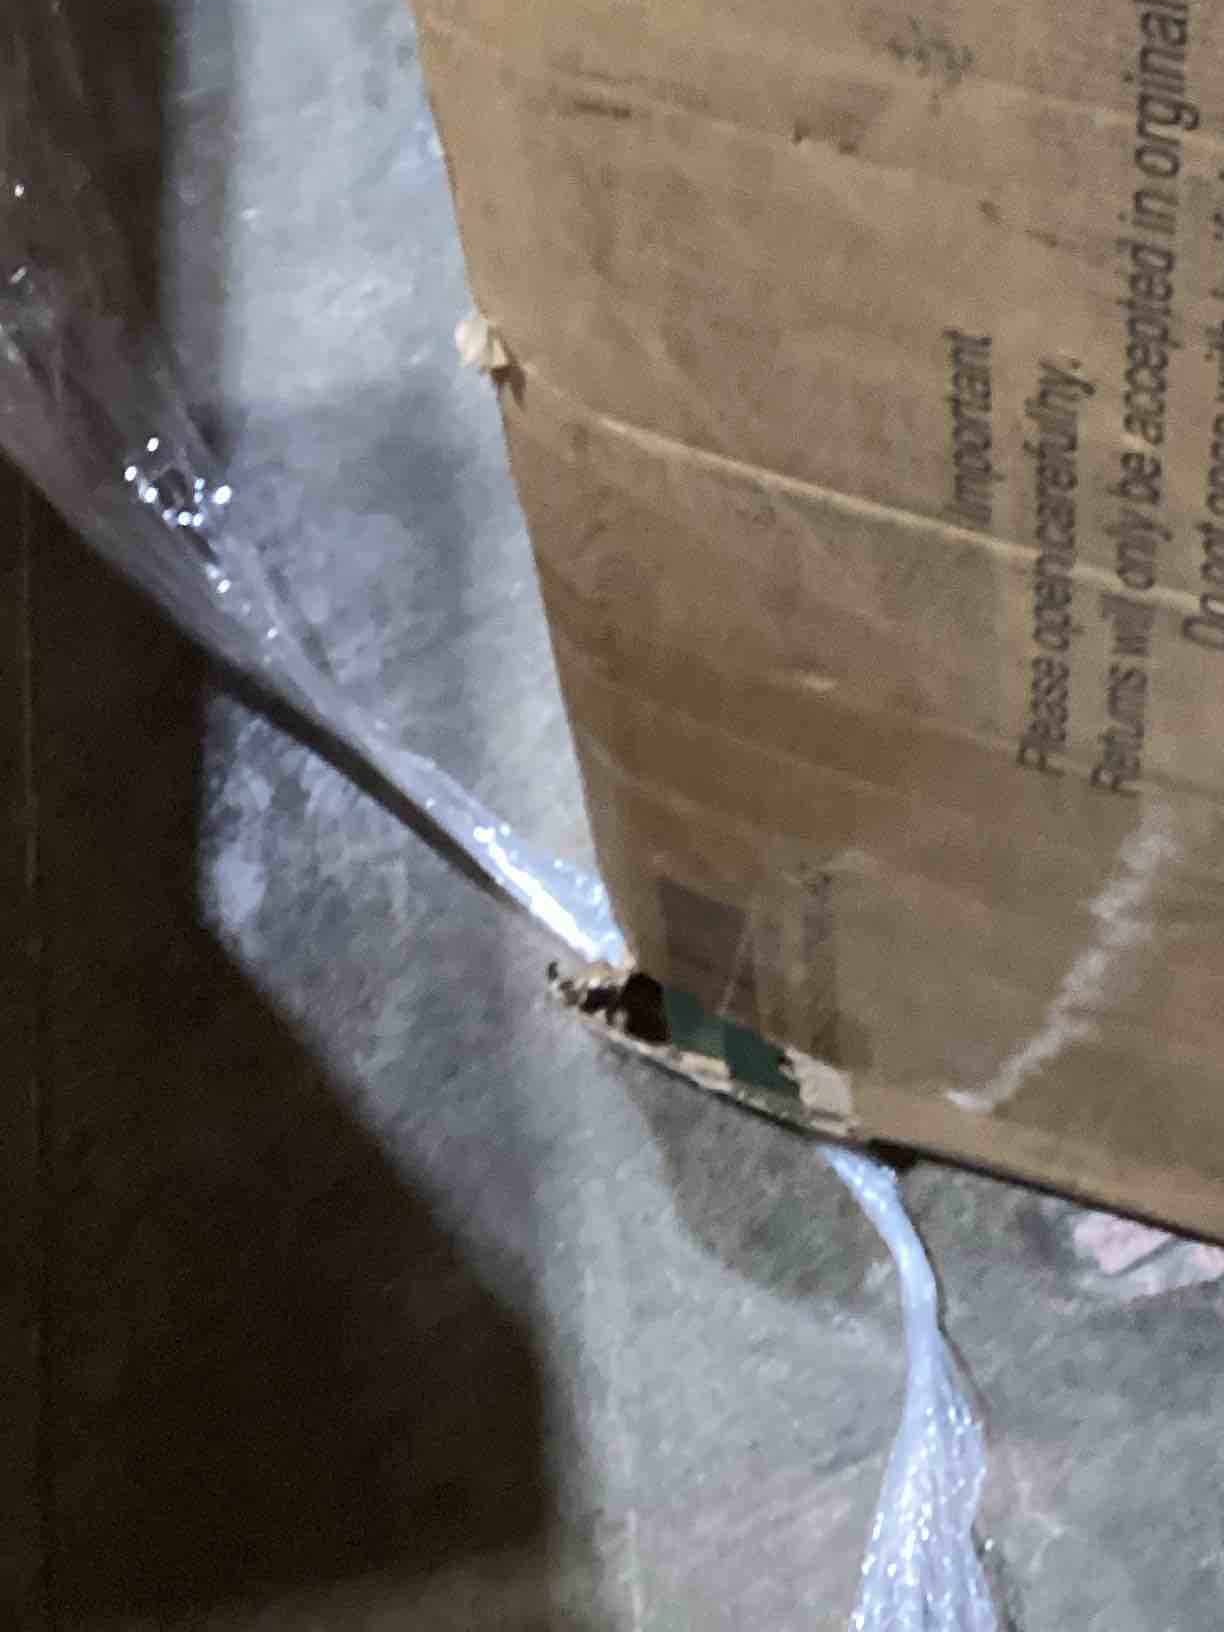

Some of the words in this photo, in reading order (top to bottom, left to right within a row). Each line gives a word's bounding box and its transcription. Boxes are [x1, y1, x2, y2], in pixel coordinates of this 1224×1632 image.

[1116, 188, 1180, 237] in
[1115, 237, 1184, 446] accepted
[942, 329, 1004, 526] Important
[1023, 355, 1096, 552] carefully.
[1108, 452, 1162, 506] be
[1032, 554, 1084, 652] open
[1106, 512, 1173, 591] only
[1102, 592, 1156, 658] will
[1016, 657, 1067, 778] Please
[1091, 667, 1147, 796] Returns
